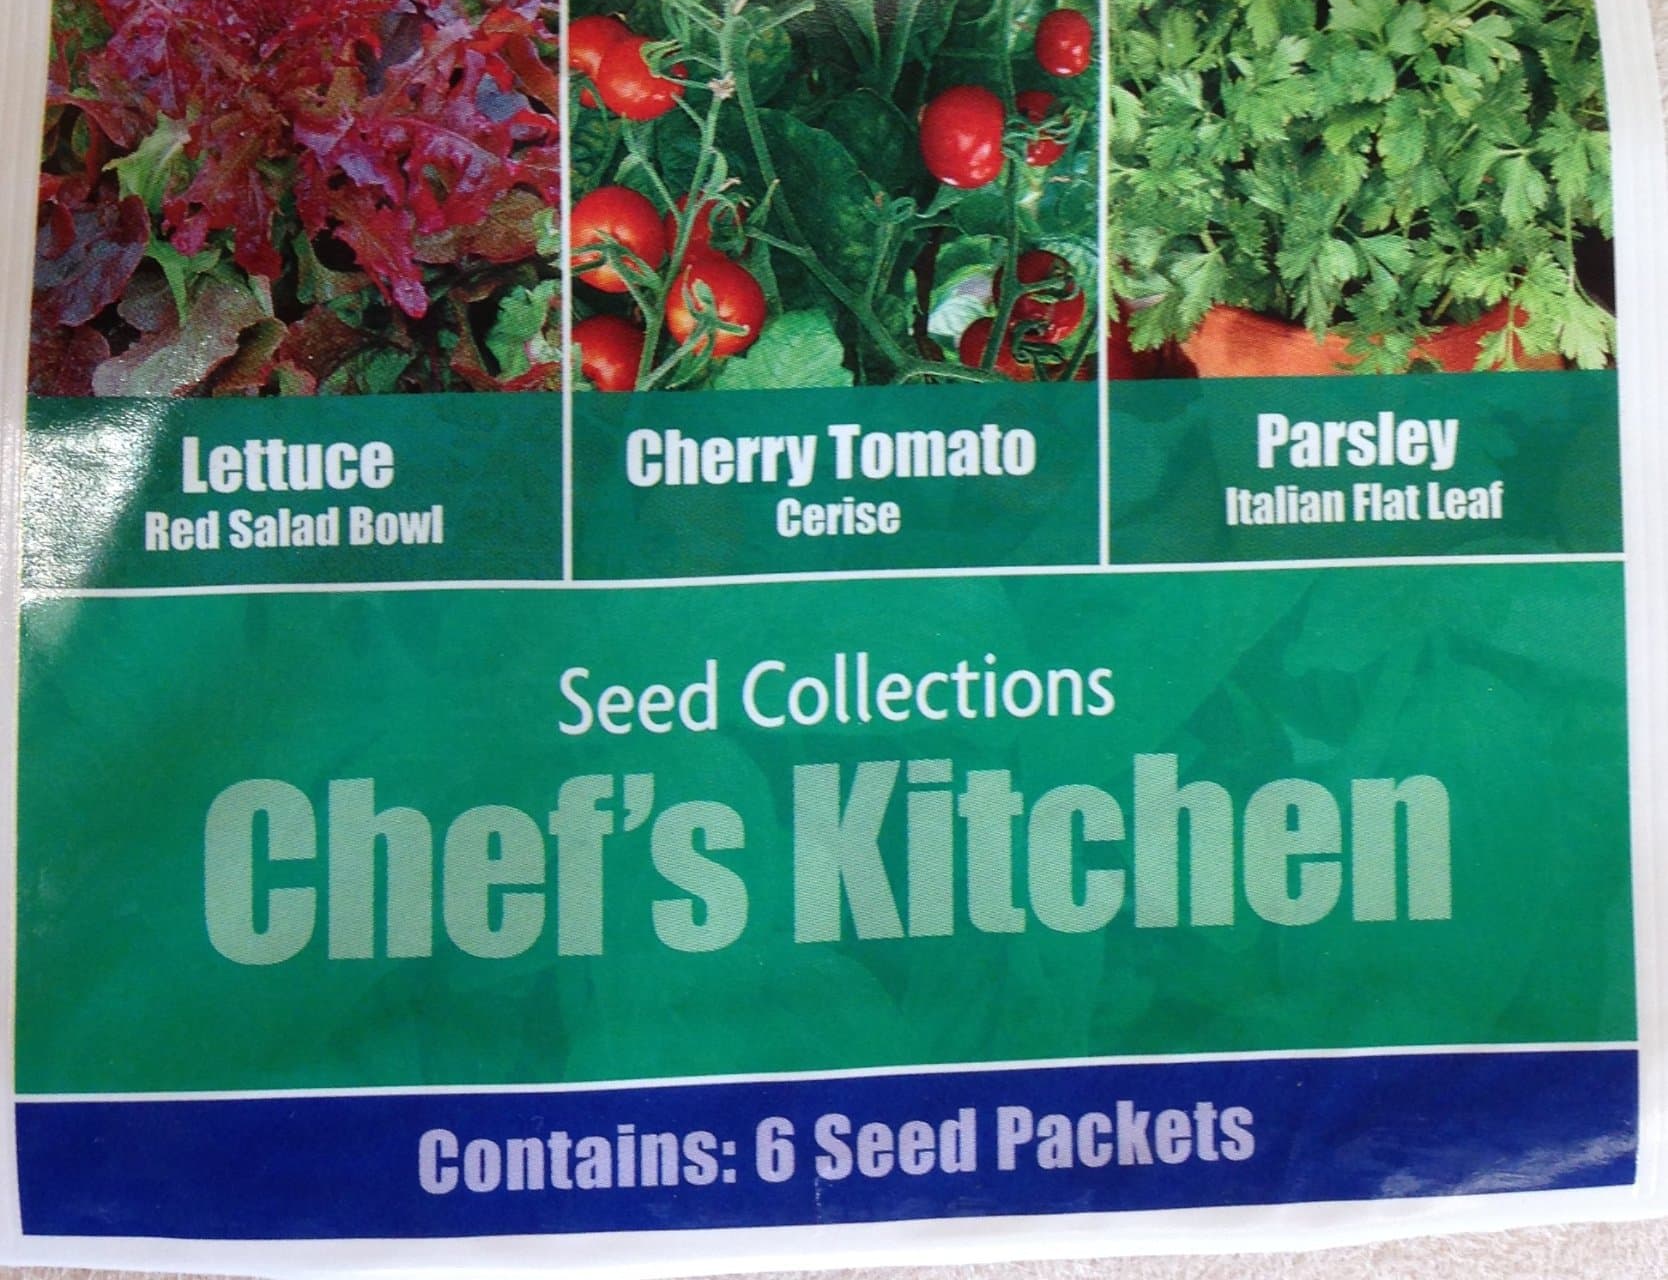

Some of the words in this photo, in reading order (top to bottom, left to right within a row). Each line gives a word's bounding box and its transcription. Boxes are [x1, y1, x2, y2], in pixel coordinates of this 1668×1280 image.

[182, 436, 395, 494] Lettuce
[626, 428, 817, 487] Cherry
[827, 423, 1037, 480] Tomato
[1257, 411, 1459, 471] Parsley
[144, 510, 219, 551] Red
[228, 506, 339, 550] Salad
[349, 505, 444, 546] Bowl
[775, 496, 901, 537] Cerise
[1225, 485, 1345, 526] Italian
[1352, 482, 1421, 522] Flat
[1427, 481, 1504, 520] Leaf
[557, 660, 718, 735] Seed
[741, 652, 1116, 728] Collections
[204, 770, 747, 966] Chef's
[792, 752, 1452, 945] Kitchen
[418, 1123, 737, 1195] Contains:
[755, 1115, 796, 1183] 6
[815, 1107, 978, 1181] Seed
[999, 1100, 1256, 1171] Packets
